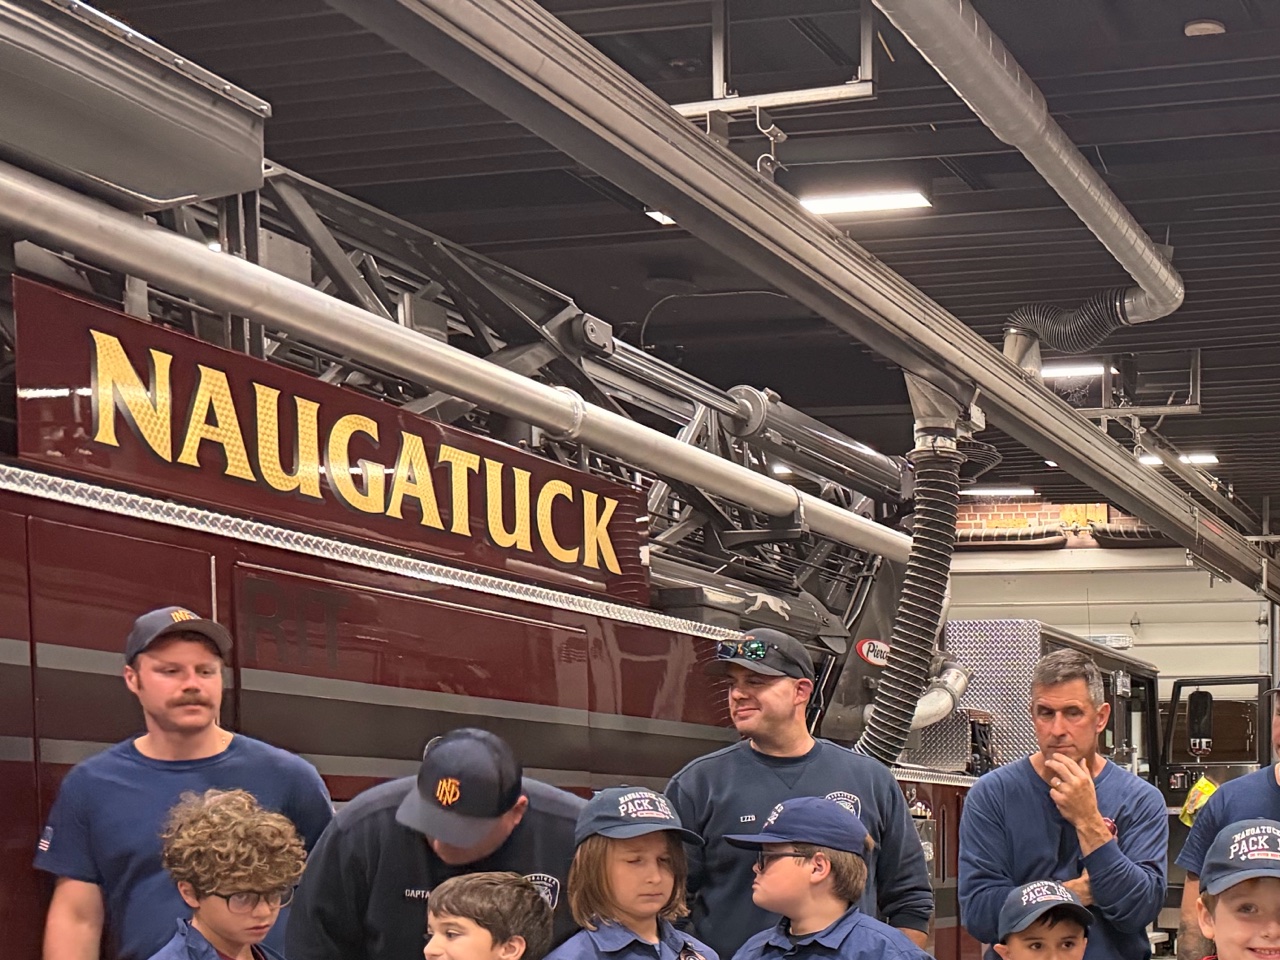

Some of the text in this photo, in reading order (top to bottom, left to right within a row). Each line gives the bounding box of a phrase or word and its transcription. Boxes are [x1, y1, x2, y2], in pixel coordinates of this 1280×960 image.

[88, 328, 624, 577] NAUGATUCK
[866, 641, 889, 661] Pierc
[618, 799, 654, 817] PACK
[1229, 834, 1269, 860] PACK
[404, 888, 431, 900] CAPTA
[1021, 886, 1051, 905] PACK
